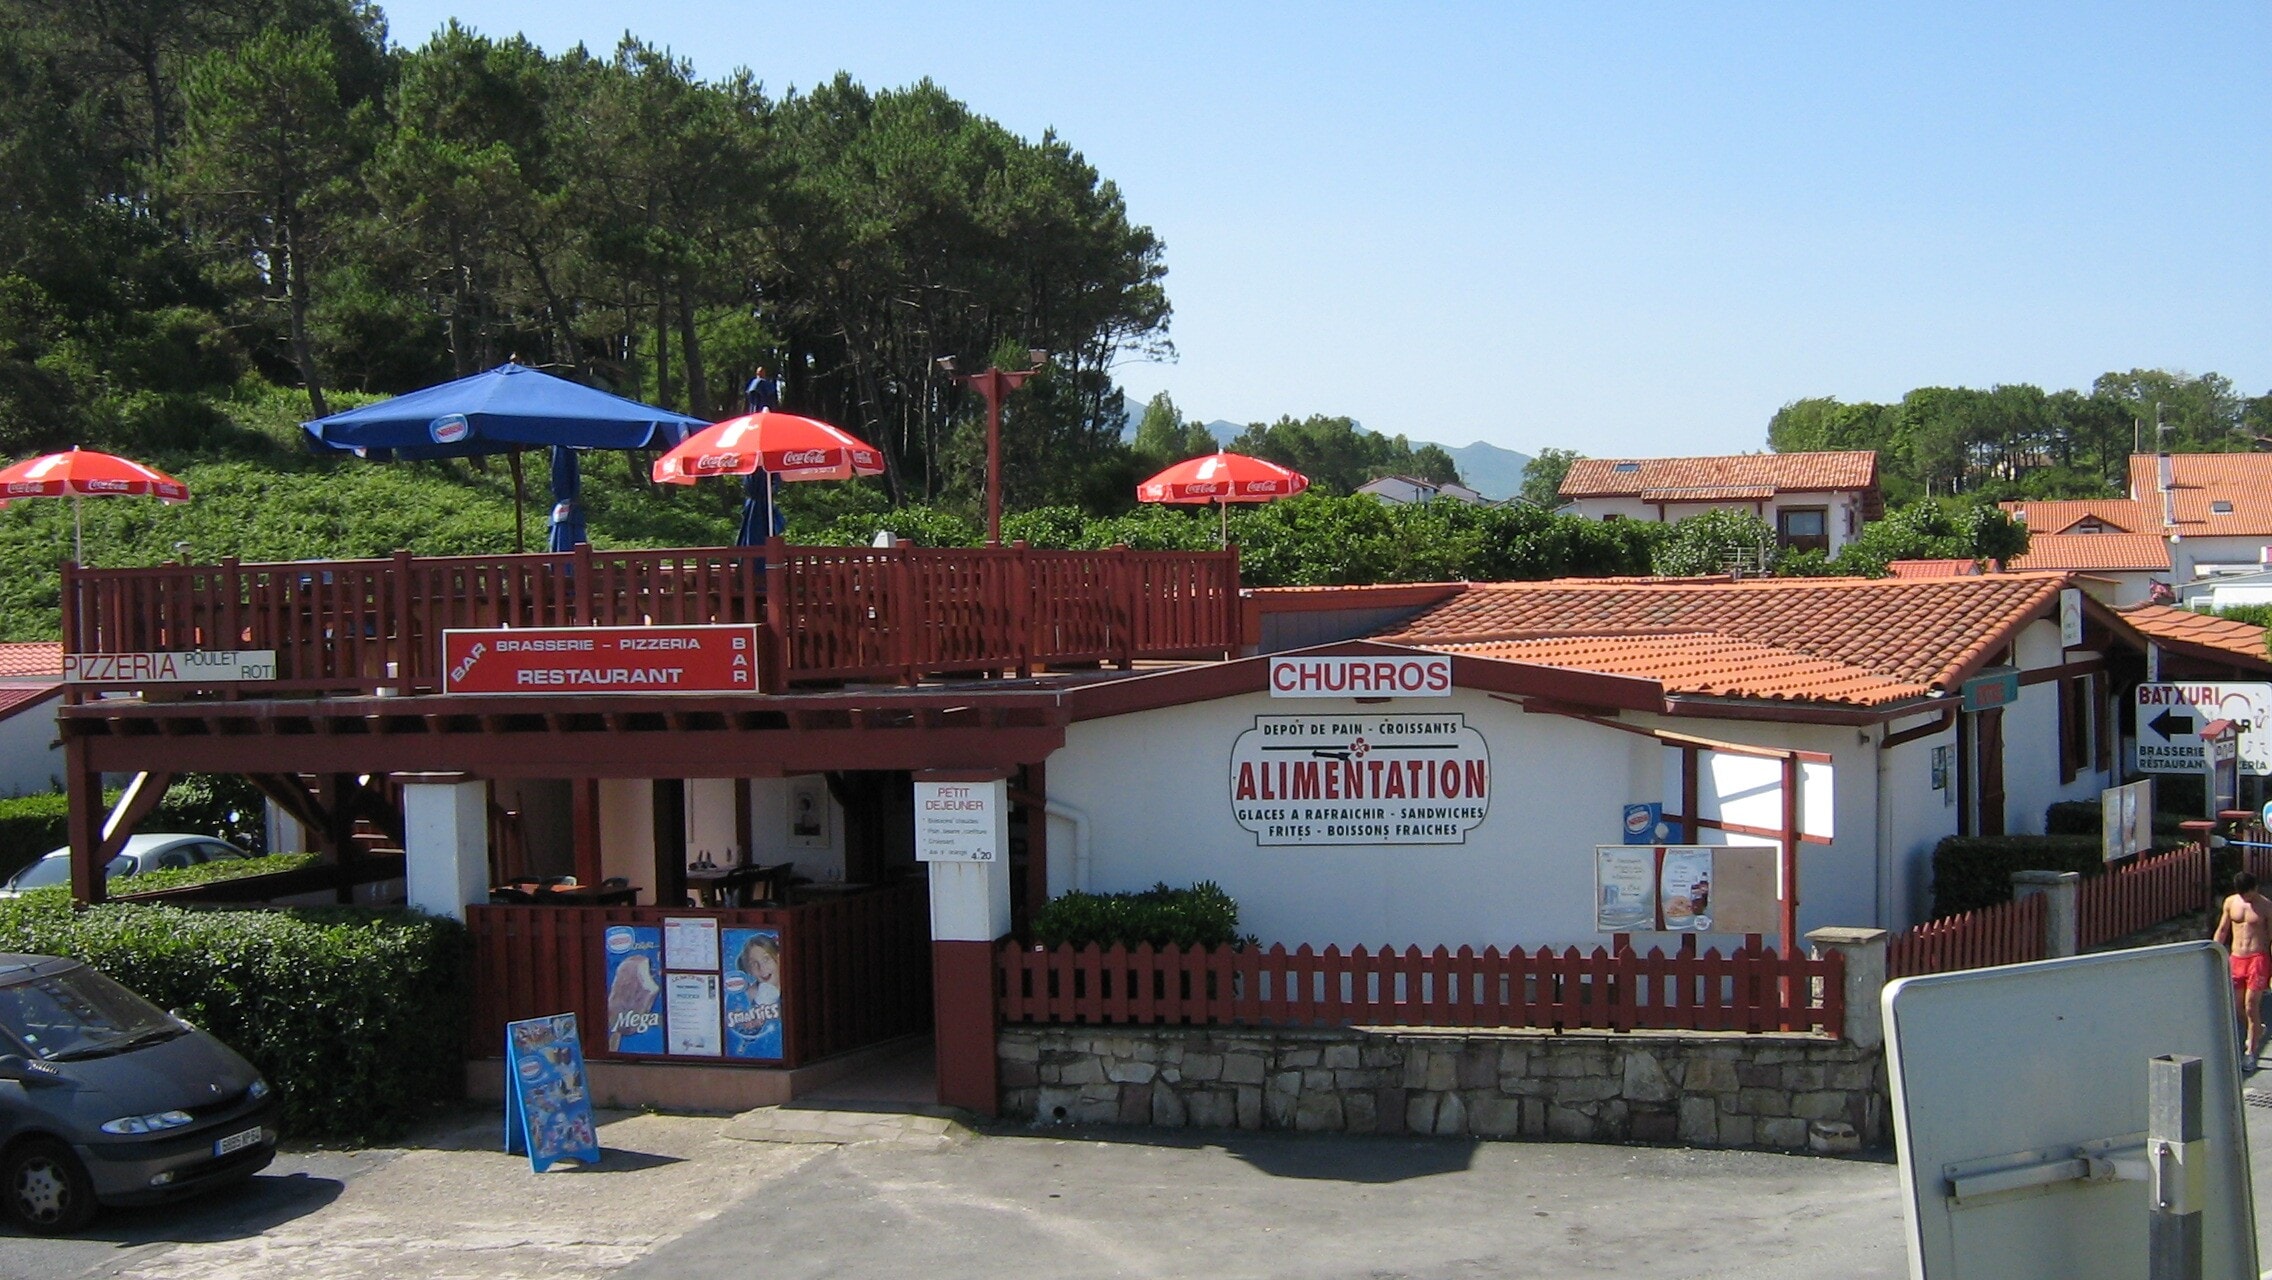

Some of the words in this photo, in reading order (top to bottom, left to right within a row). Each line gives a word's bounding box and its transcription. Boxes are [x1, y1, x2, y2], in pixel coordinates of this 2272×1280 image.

[697, 452, 742, 469] Coca-Cola
[783, 448, 827, 467] Coca-Cola
[495, 639, 594, 652] BRASSERIE
[619, 638, 701, 651] PIZZERIA
[63, 653, 178, 681] PIZZERIA
[184, 651, 239, 667] POULET
[450, 641, 488, 683] BAR
[732, 637, 748, 683] BAR
[517, 668, 683, 685] RESTAURANT
[1272, 662, 1449, 692] CHURROS
[2138, 686, 2220, 706] BATXURI
[1263, 723, 1304, 736] DEPOT
[1310, 723, 1326, 735] DE
[1332, 723, 1363, 735] PAIN
[1379, 722, 1457, 735] CROISSANTS
[2139, 745, 2205, 757] BRASSERIE
[1236, 759, 1485, 801] ALIMENTATION
[937, 787, 970, 797] PETIT
[925, 800, 983, 811] DEJEUNER
[1238, 808, 1285, 821] GLACES
[1291, 808, 1299, 820] A
[1305, 808, 1385, 820] RAFRAICHIR
[1401, 807, 1484, 820] SANDWICHES
[1268, 826, 1311, 837] FRITES
[1327, 825, 1389, 837] BOISSONS
[1395, 824, 1457, 837] FRAICHES
[611, 1009, 660, 1034] Mega
